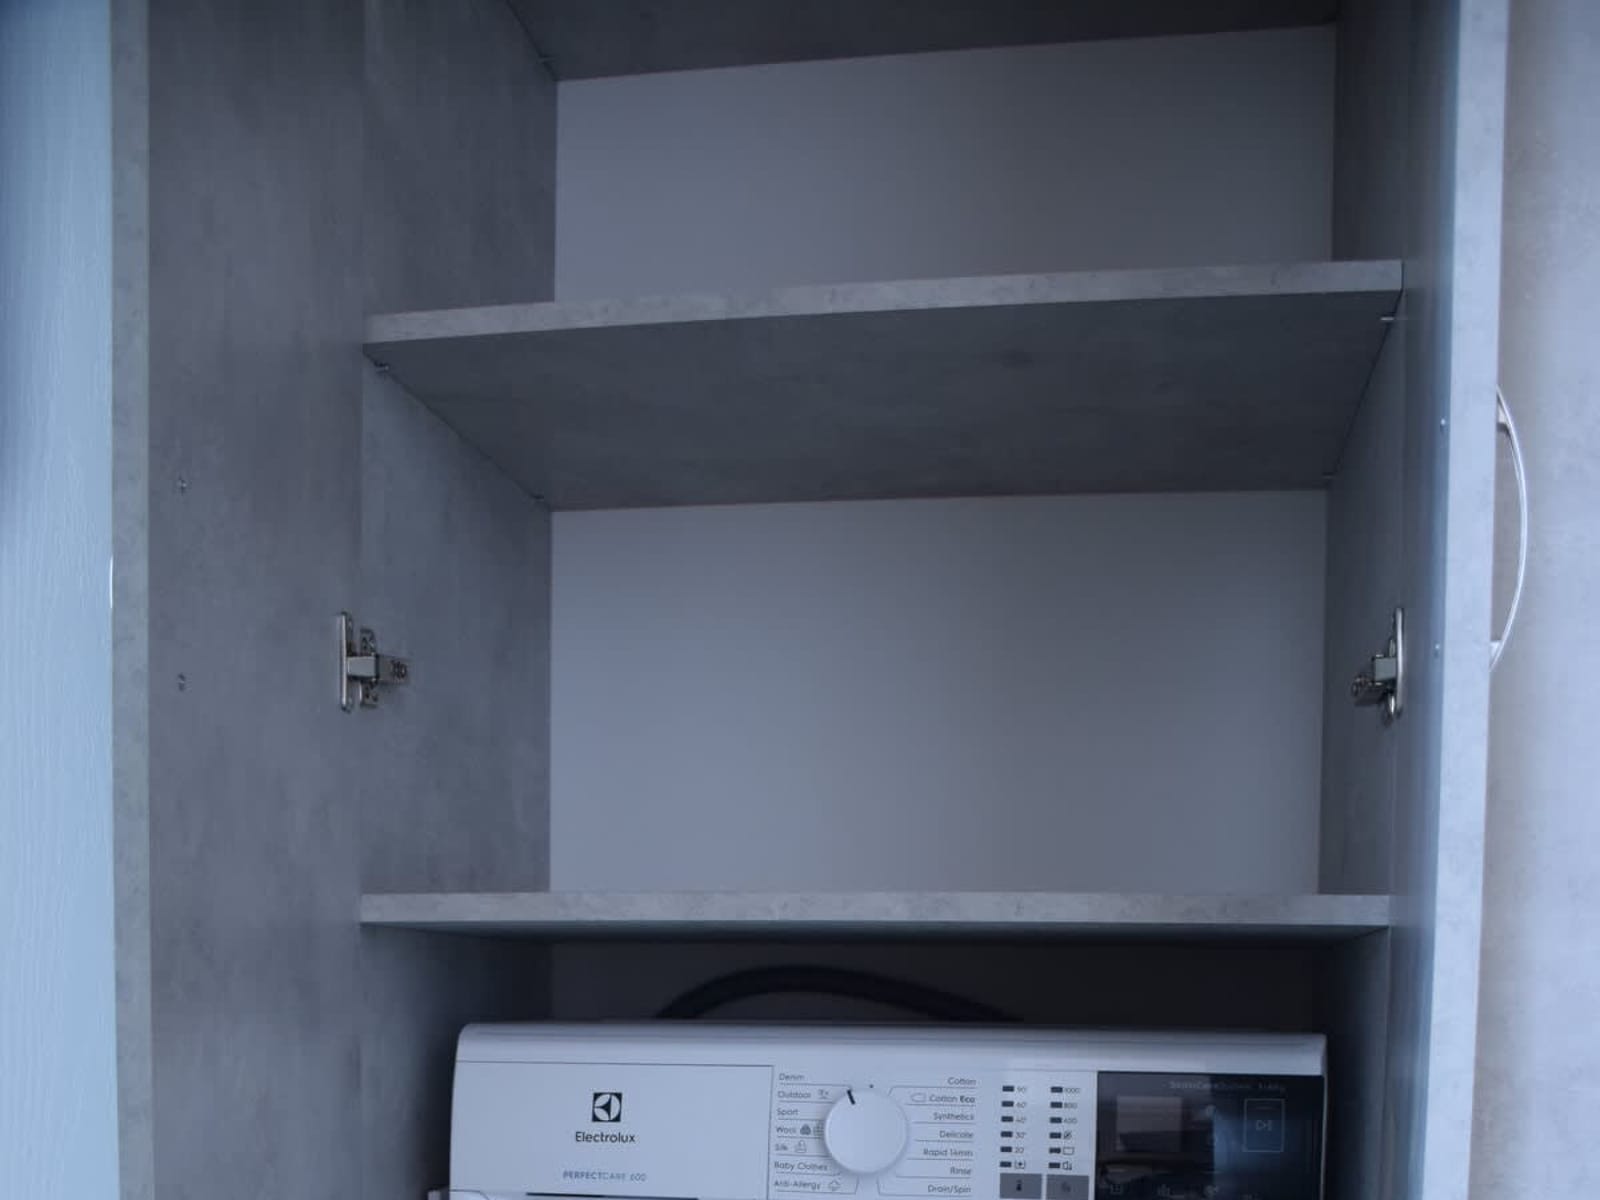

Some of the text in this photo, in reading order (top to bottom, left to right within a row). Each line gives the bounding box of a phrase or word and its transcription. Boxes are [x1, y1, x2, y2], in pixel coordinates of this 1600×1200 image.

[959, 1095, 976, 1104] Eco
[776, 1107, 799, 1116] Sport
[932, 1112, 975, 1121] Synthetics
[575, 1131, 636, 1144] Electrolux
[774, 1161, 828, 1171] Baby Clothes
[562, 1170, 648, 1182] PERFECTCARE 600
